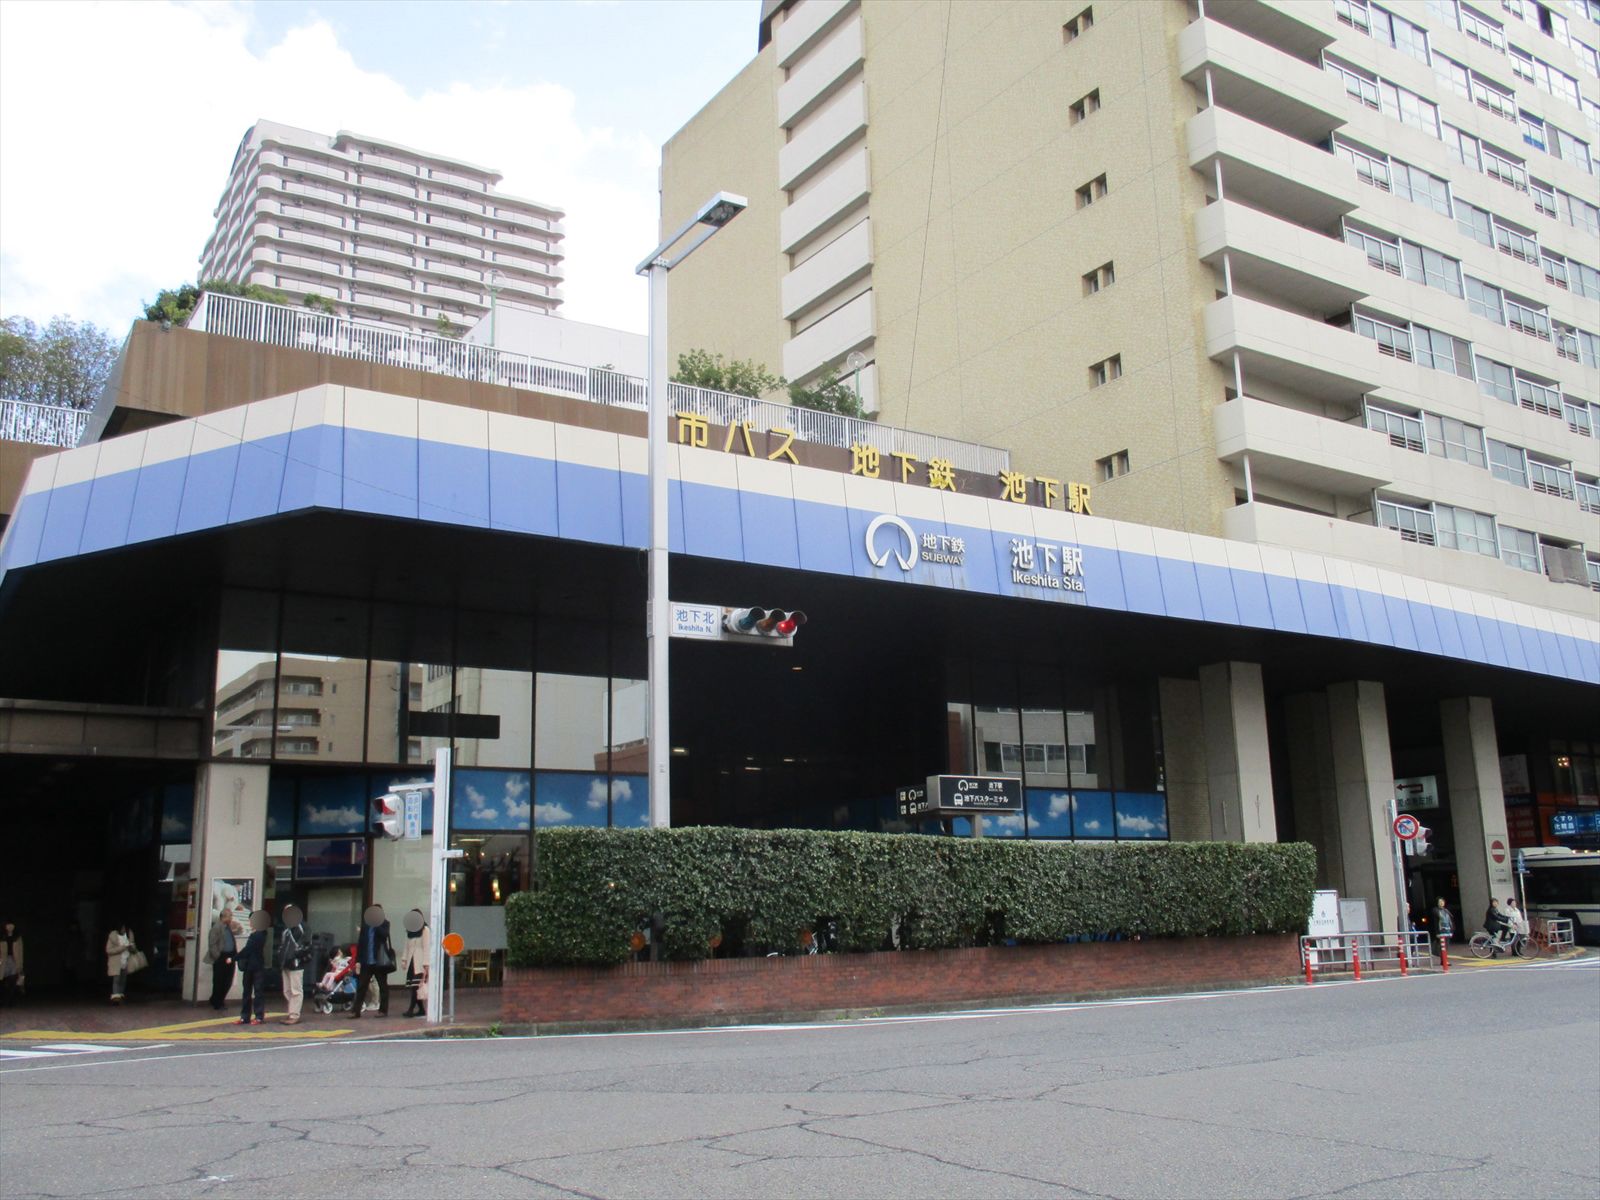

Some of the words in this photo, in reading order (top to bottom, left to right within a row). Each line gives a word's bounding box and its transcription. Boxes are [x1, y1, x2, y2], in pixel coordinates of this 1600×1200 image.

[676, 411, 800, 465] 市バス
[850, 442, 957, 492] 地下鉄
[999, 469, 1094, 515] 池下駅
[921, 533, 966, 555] 地下鉄
[921, 550, 966, 566] SUBWAY
[1010, 538, 1085, 577] 池下駅
[1012, 568, 1060, 589] Ikeshita
[1062, 575, 1086, 593] Sta.
[676, 609, 715, 625] 池下北
[678, 623, 704, 633] Ikeshita
